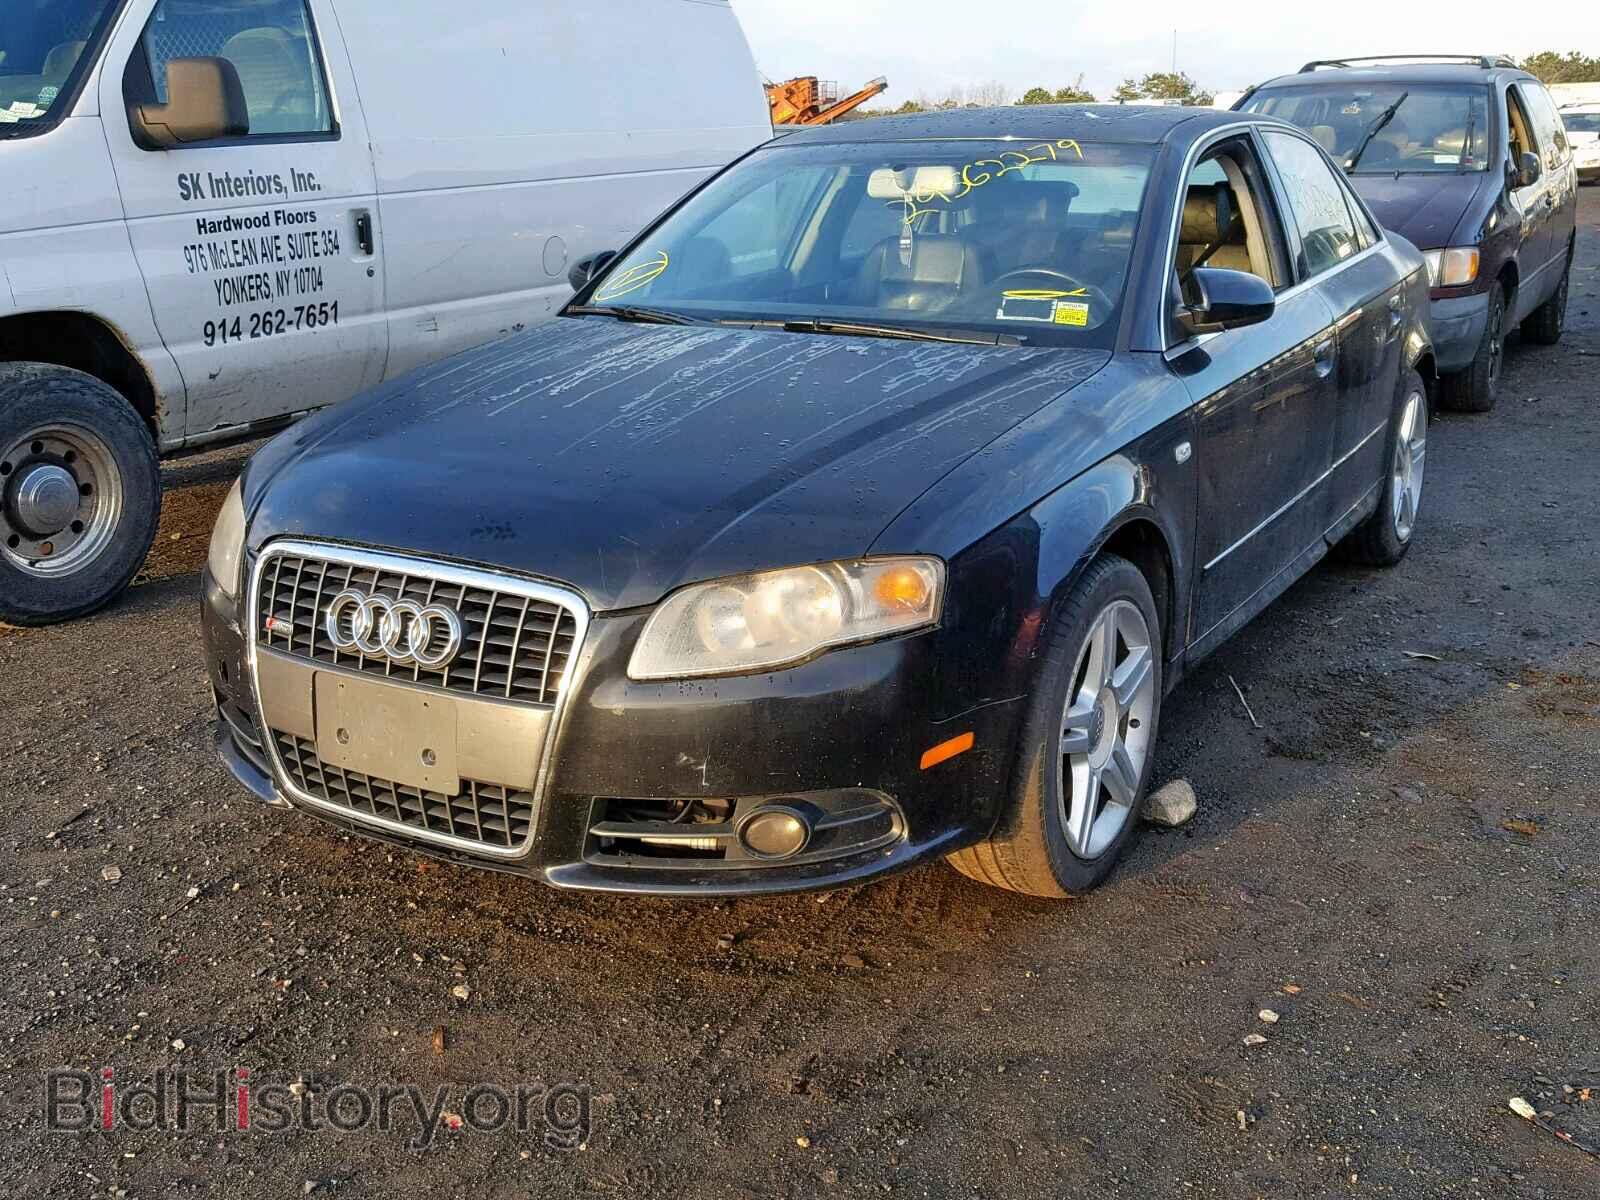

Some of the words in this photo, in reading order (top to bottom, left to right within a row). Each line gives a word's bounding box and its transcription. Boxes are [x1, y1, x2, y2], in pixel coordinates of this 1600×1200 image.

[178, 171, 206, 200] SK
[208, 169, 288, 199] Interiors,
[290, 168, 321, 192] Inc.
[196, 212, 270, 235] Hardwood
[274, 209, 317, 226] Floors
[184, 243, 208, 273] 976
[207, 238, 259, 271] McLEAN
[260, 235, 287, 266] AVE,
[287, 231, 320, 260] SUITE
[321, 229, 340, 256] 354
[214, 272, 274, 306] YONKERS,
[276, 270, 291, 298] NY
[294, 266, 323, 294] 10704
[203, 316, 242, 347] 914
[250, 300, 339, 339] 262-7651
